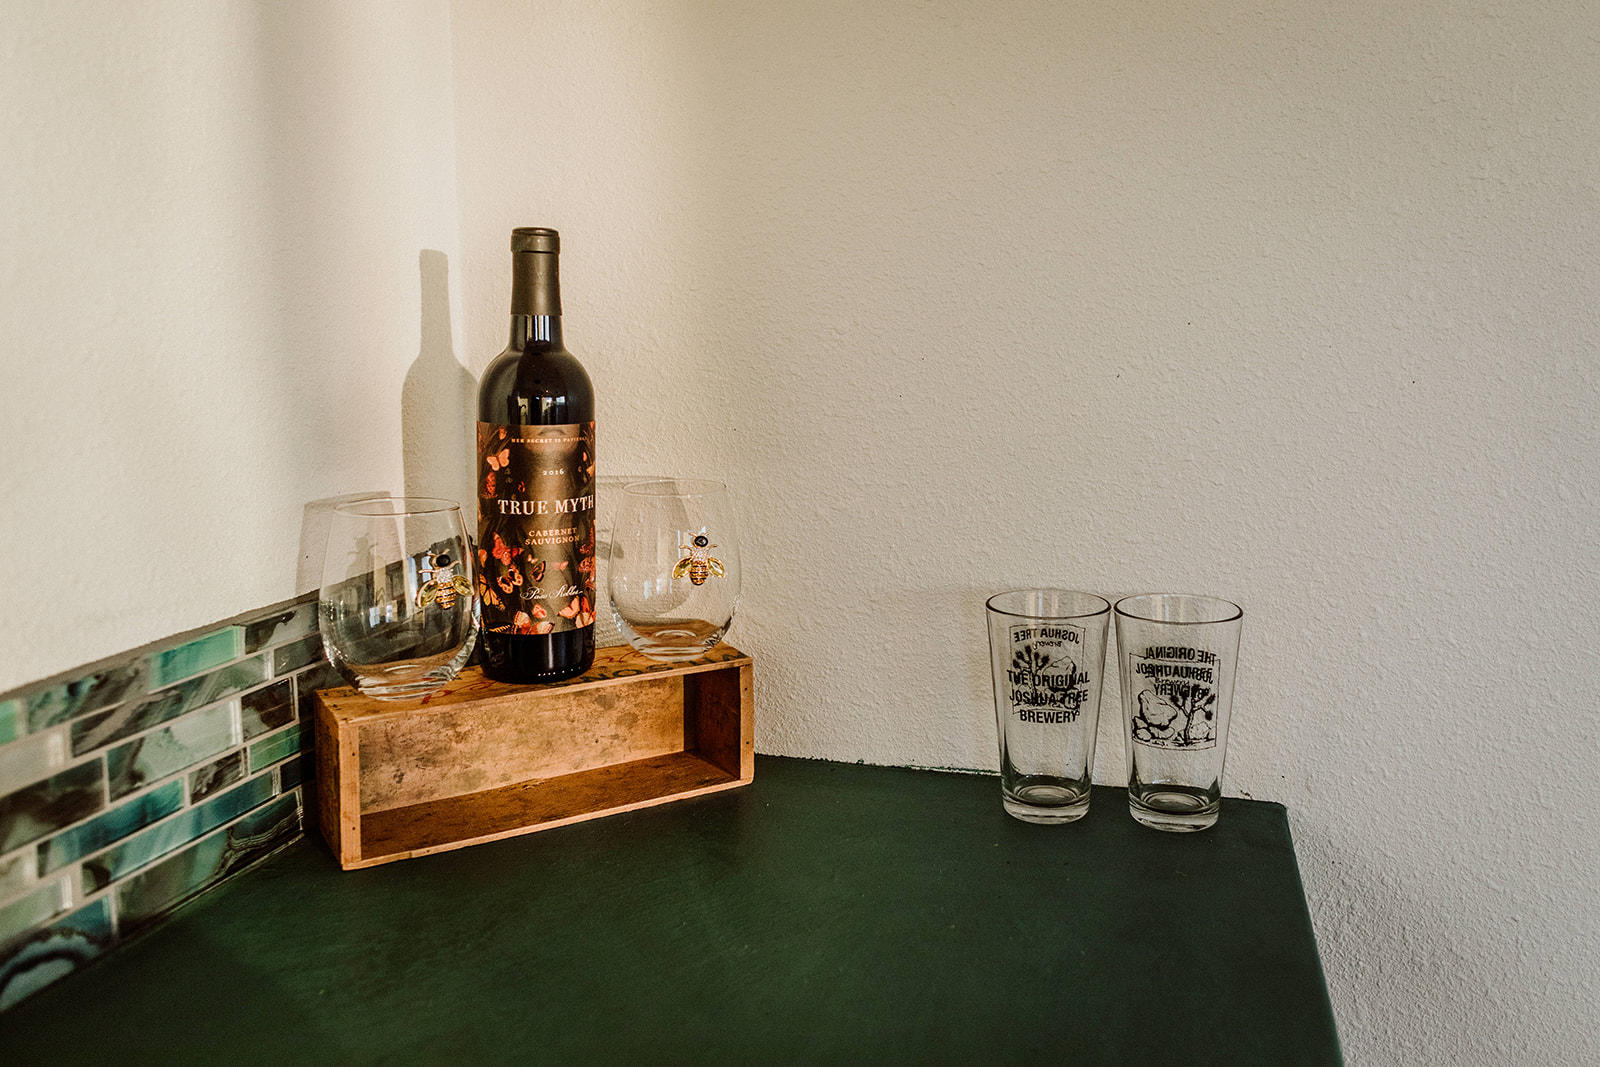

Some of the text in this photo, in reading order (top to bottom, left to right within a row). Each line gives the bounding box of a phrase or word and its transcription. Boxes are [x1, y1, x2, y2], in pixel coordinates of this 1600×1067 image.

[543, 468, 565, 476] 2016
[498, 494, 594, 515] TRUE MYTH
[528, 527, 578, 537] CABERNET
[524, 535, 580, 546] SAUVIGNON
[1032, 671, 1091, 687] ORIGINAL
[1009, 688, 1058, 706] JOSHUA
[1019, 708, 1079, 724] BREWERY
